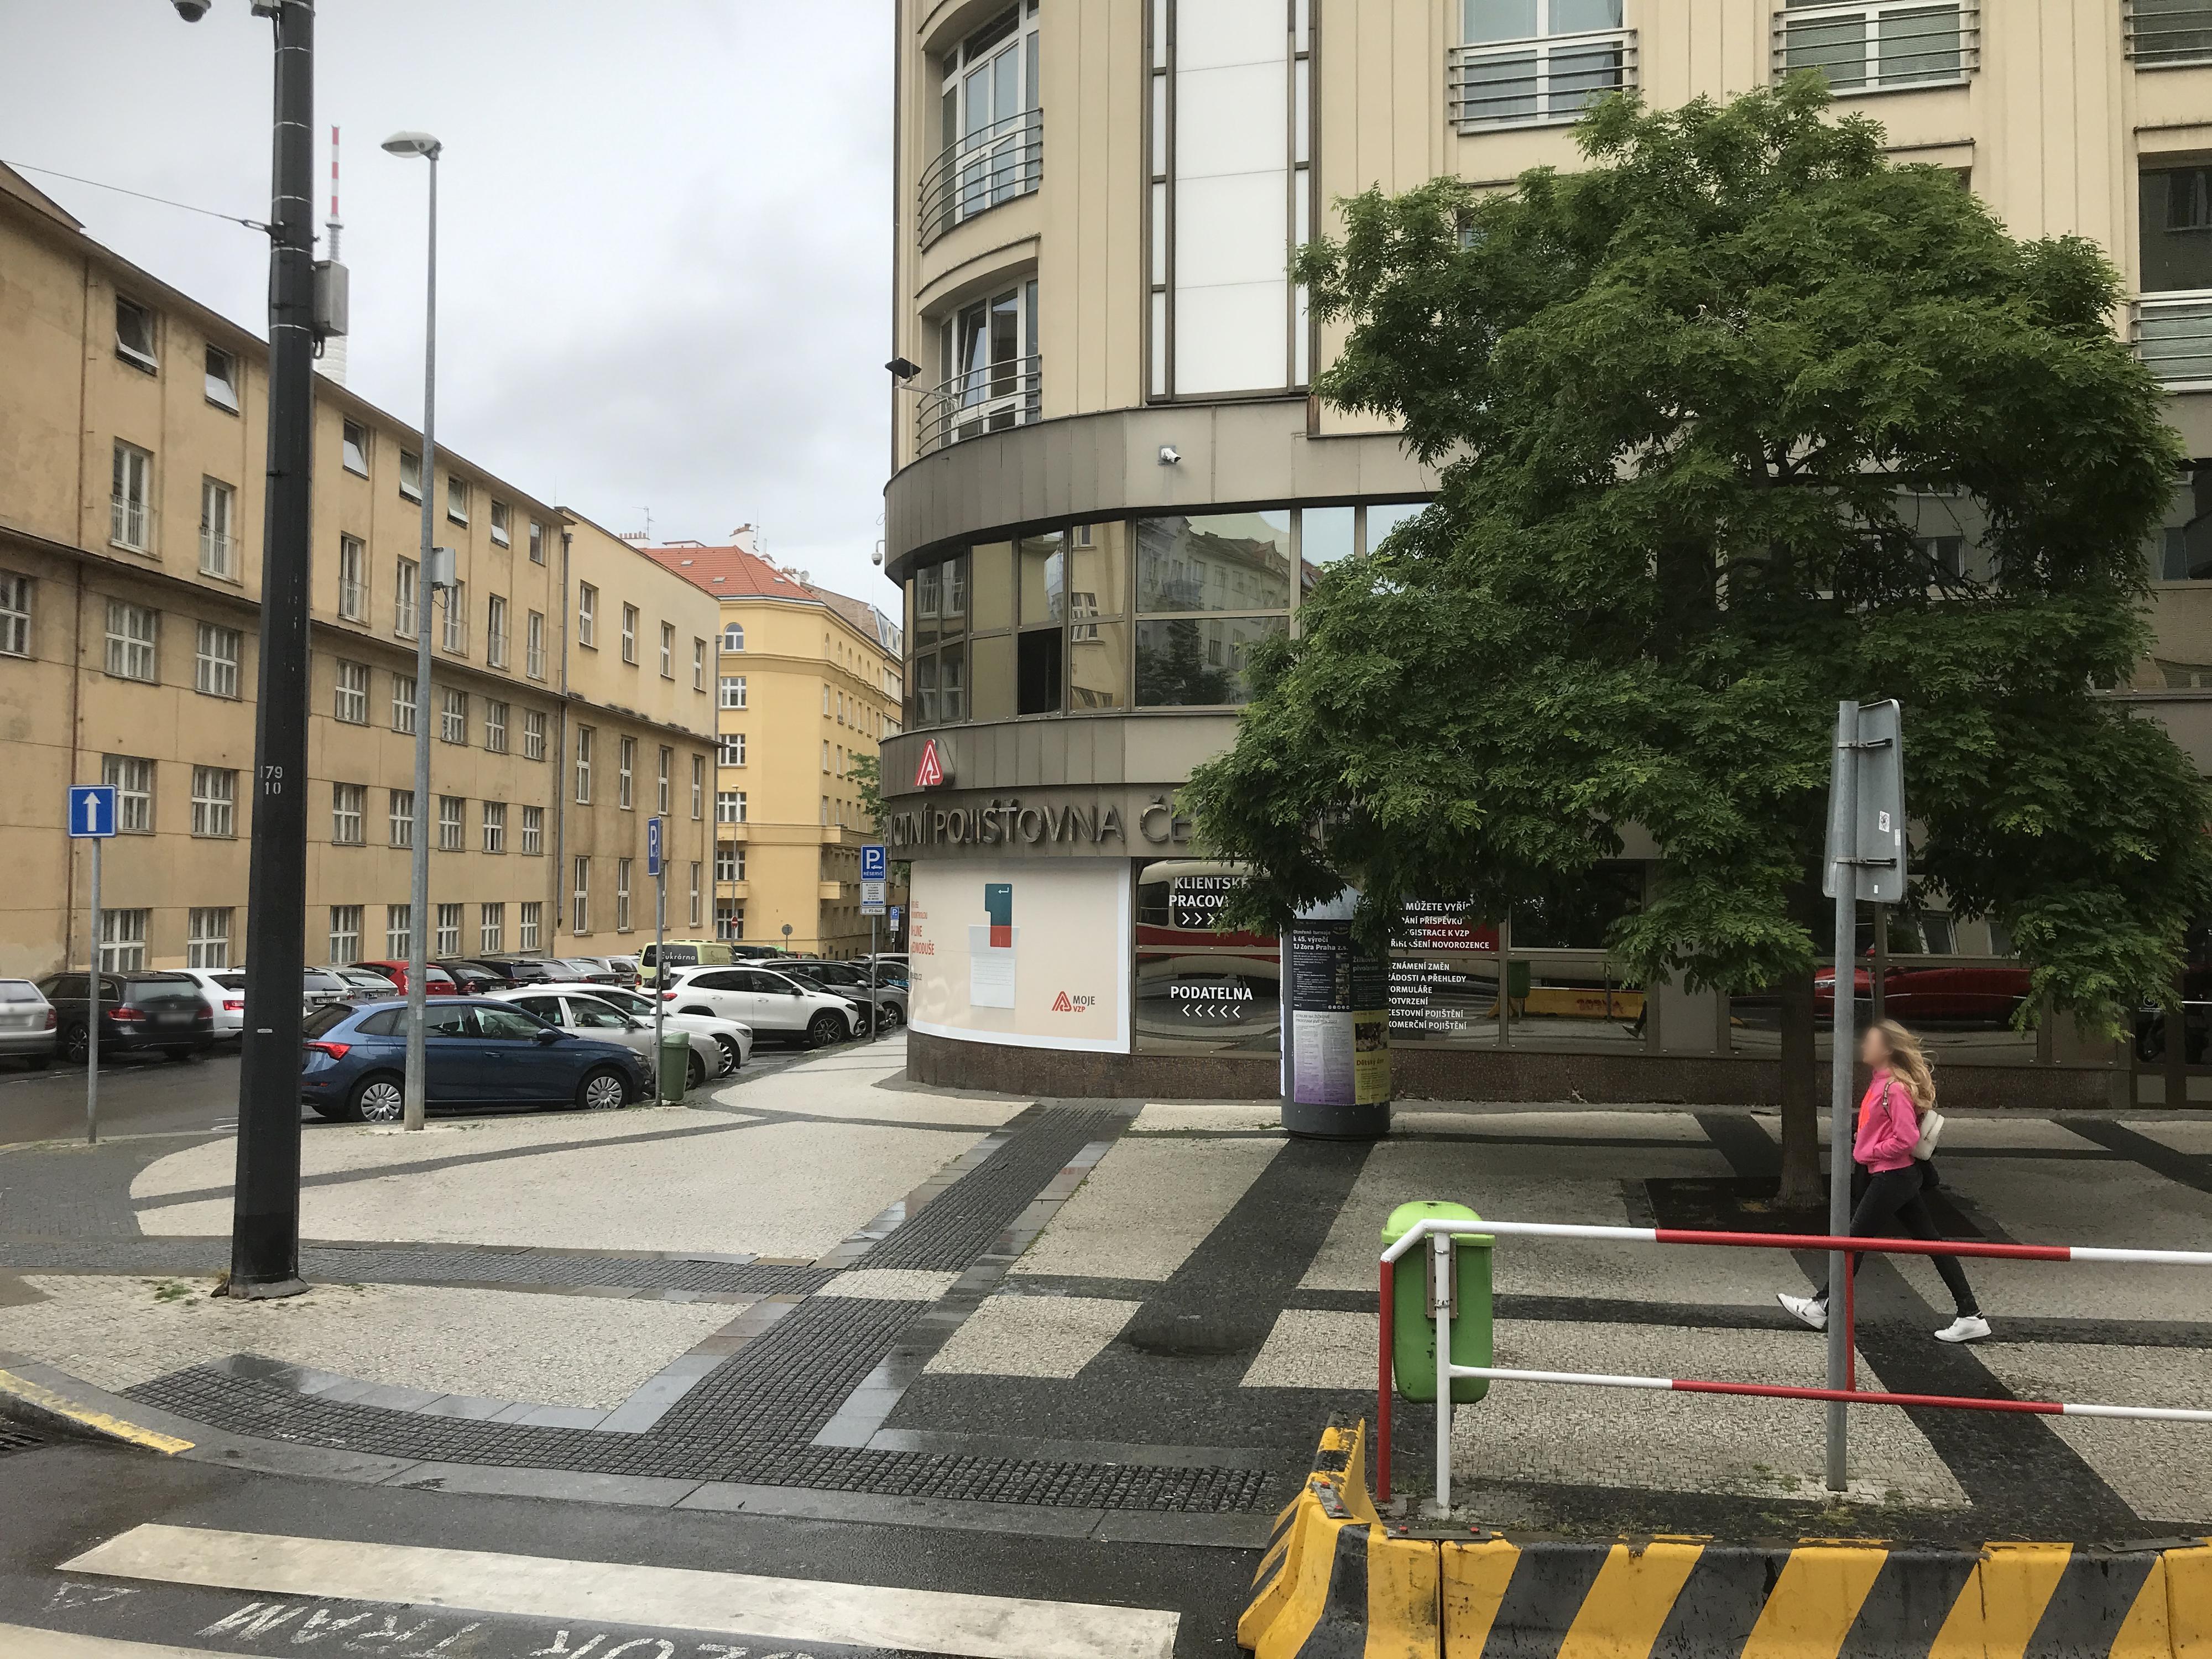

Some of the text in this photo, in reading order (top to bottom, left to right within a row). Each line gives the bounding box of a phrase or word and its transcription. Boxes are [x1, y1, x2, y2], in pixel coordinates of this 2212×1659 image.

[260, 765, 283, 779] 179
[265, 781, 281, 795] 10
[935, 798, 1125, 844] POJIŠŤOVNA
[650, 825, 658, 857] P
[866, 849, 880, 869] P
[1406, 900, 1442, 911] MŮŽETE
[1389, 961, 1449, 971] ZNÁMENÍ ZMĚN
[1428, 973, 1467, 983] PŘEHLEDY
[1170, 986, 1253, 1000] PODATELNA
[1389, 985, 1433, 994] ORMULÁŘE
[1073, 995, 1095, 1006] MOJE
[1425, 1009, 1464, 1018] POJIŠTĚNÍ
[1428, 1020, 1467, 1030] POJIŠTĚNÍ
